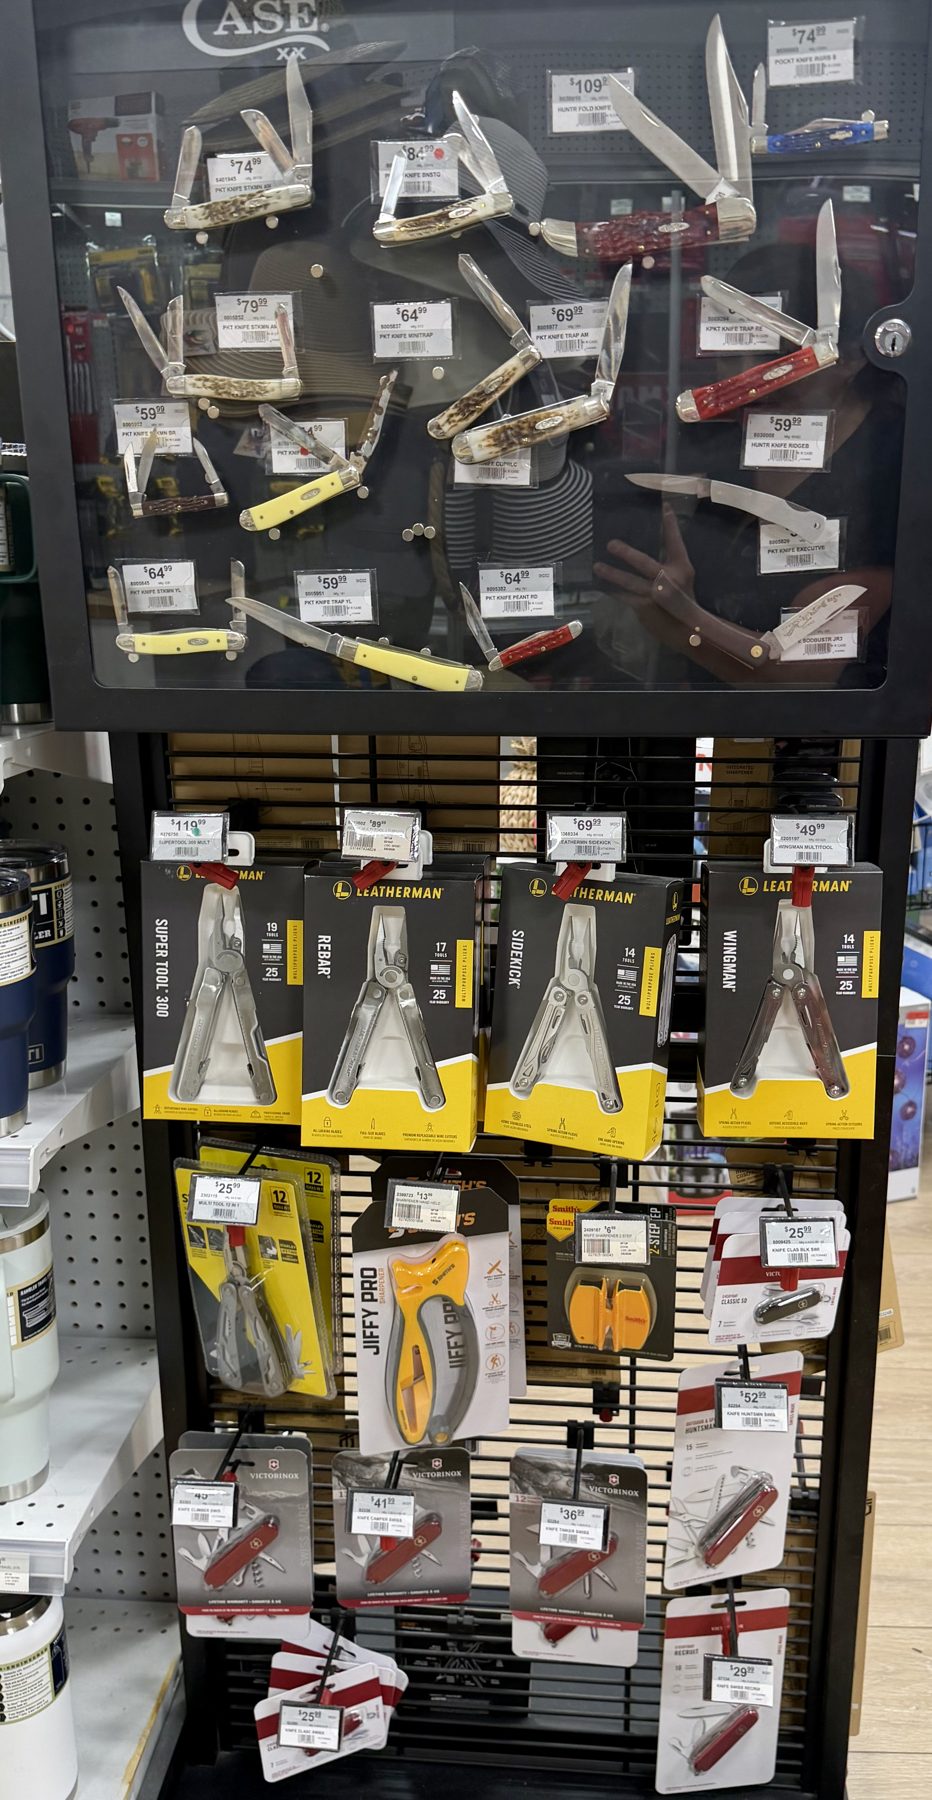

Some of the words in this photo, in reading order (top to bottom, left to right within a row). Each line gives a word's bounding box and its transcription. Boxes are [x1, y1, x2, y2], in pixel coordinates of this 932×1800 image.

[763, 880, 853, 892] LEATRMAN
[266, 922, 278, 932] 19
[155, 918, 168, 957] SUPER
[843, 934, 855, 944] 14
[435, 942, 447, 952] 17
[624, 947, 636, 958] 14
[317, 934, 332, 979] REBAR
[508, 929, 525, 990] SIDEKICK
[722, 930, 737, 992] WINGMAN
[155, 961, 169, 993] TOOL
[265, 967, 279, 977] 25
[839, 980, 853, 991] 25
[432, 989, 447, 1000] 25
[617, 994, 631, 1005] 25
[156, 995, 169, 1018] 300
[306, 1171, 322, 1185] 12
[272, 1189, 288, 1204] 12
[360, 1267, 378, 1302] PRO
[721, 1297, 741, 1305] CLASSIC
[361, 1308, 380, 1355] JIFFY
[250, 1472, 300, 1480] VICTORINOX
[412, 1470, 462, 1479] VICTORINOX
[588, 1485, 640, 1497] VICTORINOX
[673, 1648, 699, 1656] RECRUIT
